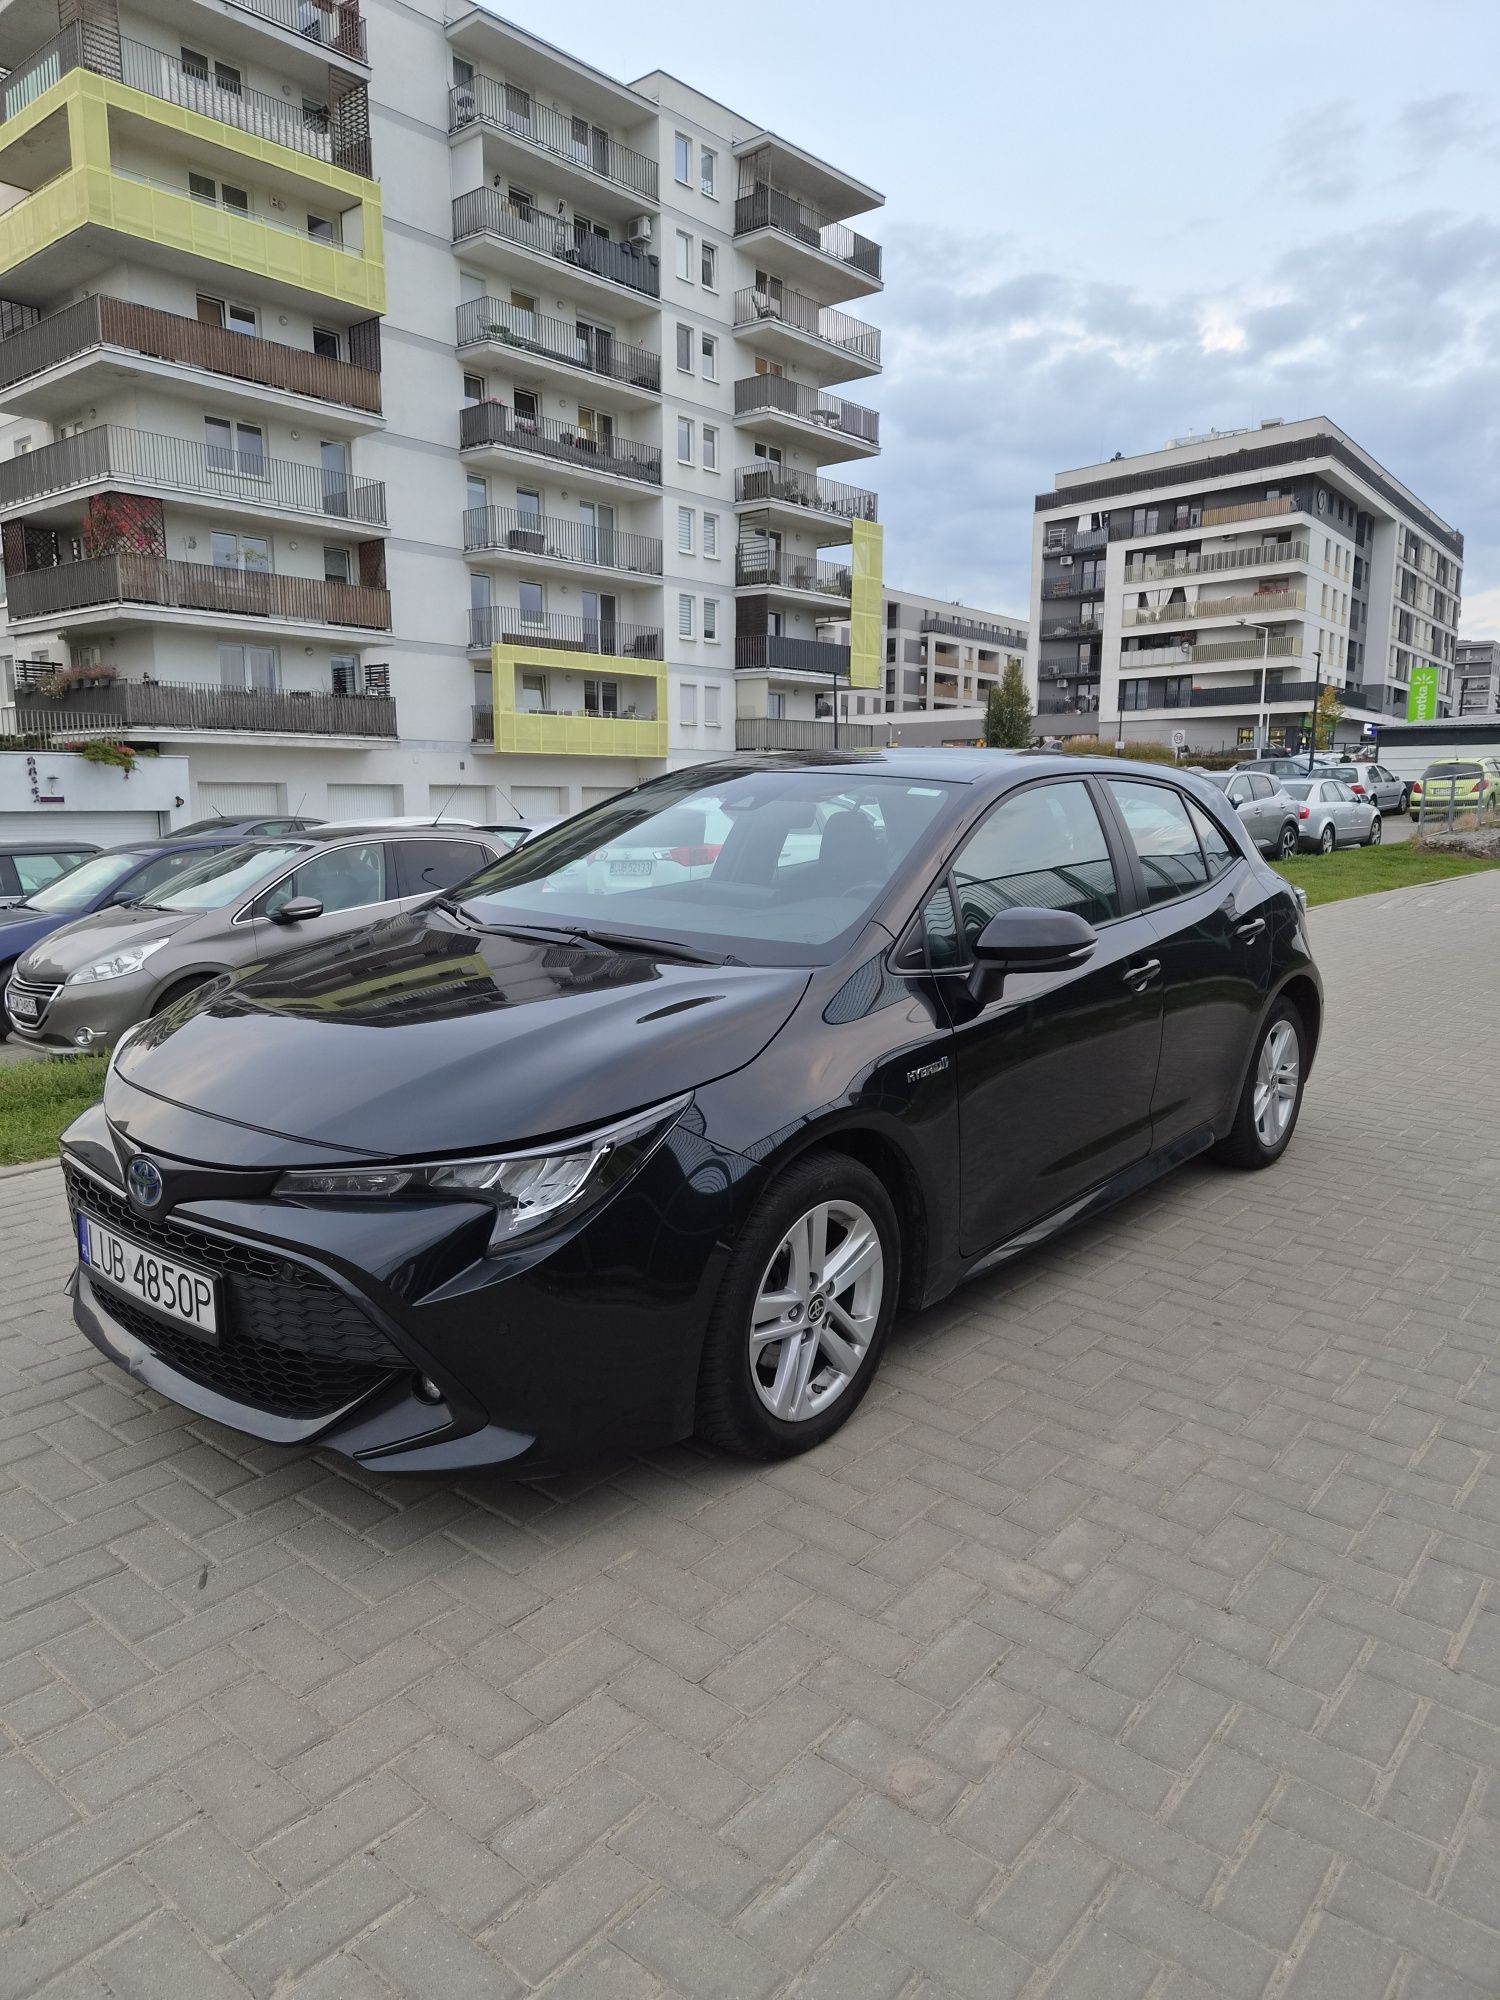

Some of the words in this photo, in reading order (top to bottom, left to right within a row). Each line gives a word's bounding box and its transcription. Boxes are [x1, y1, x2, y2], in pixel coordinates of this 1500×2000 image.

[907, 1060, 943, 1084] HYBRID
[82, 1243, 89, 1258] PL
[88, 1223, 125, 1283] LUB
[133, 1254, 211, 1322] 4850P
